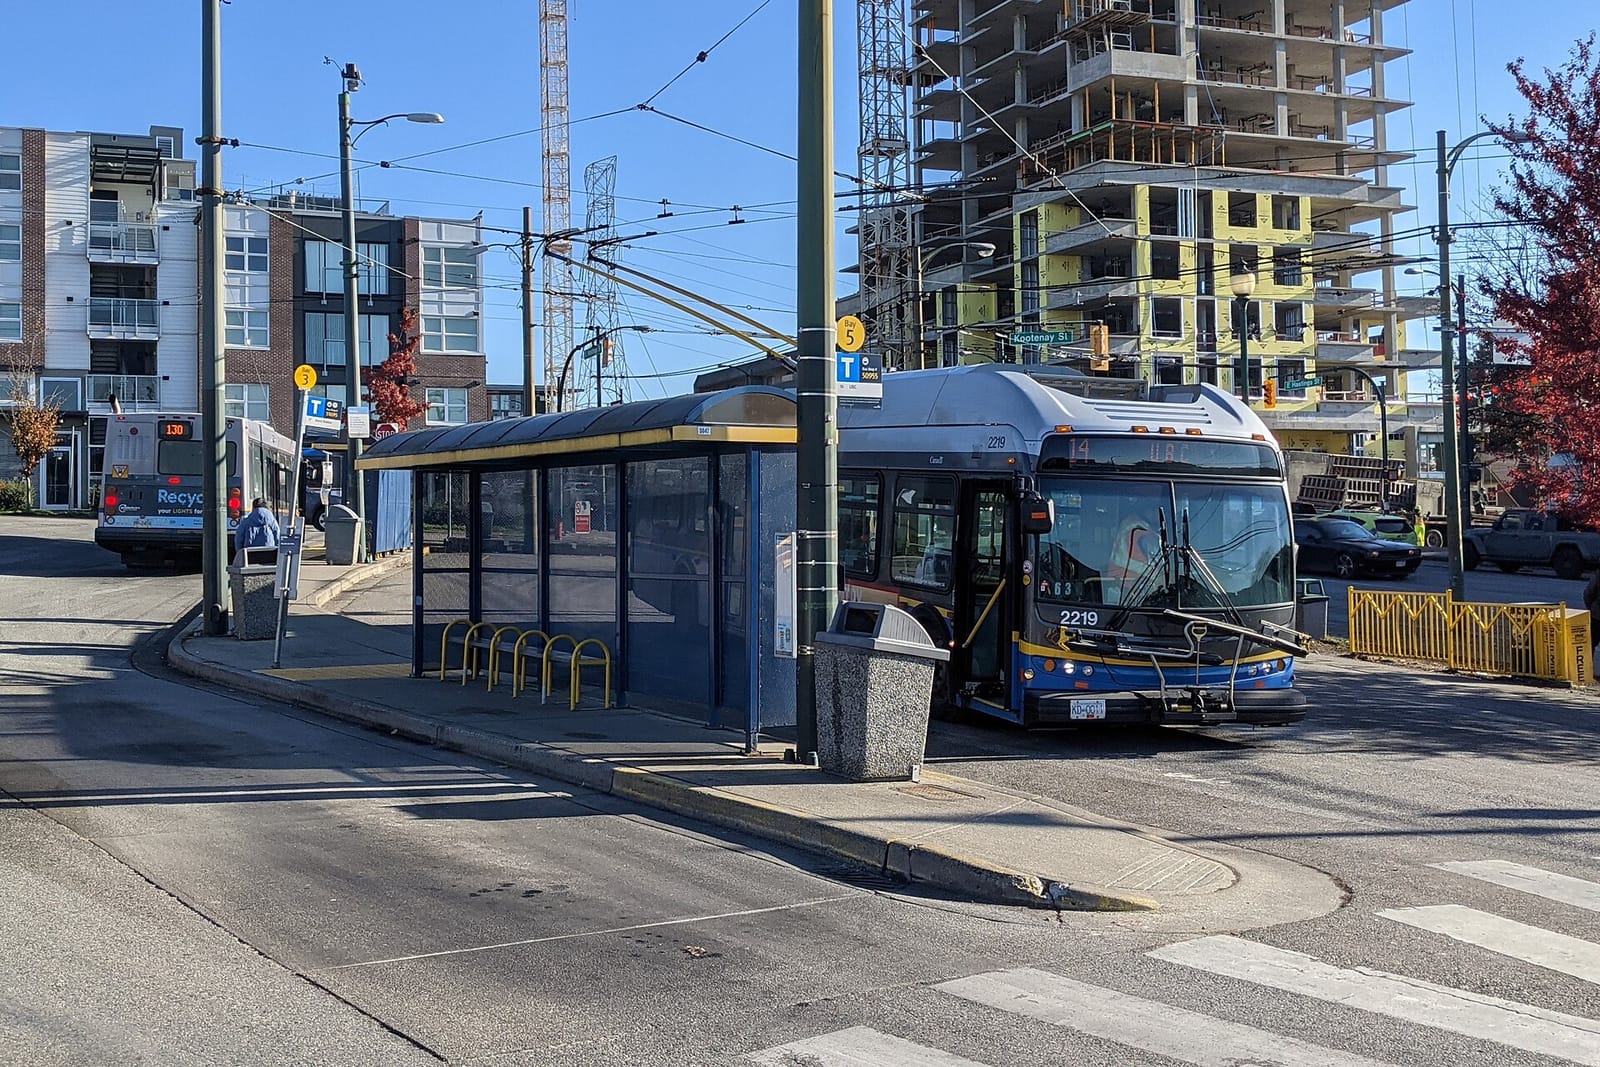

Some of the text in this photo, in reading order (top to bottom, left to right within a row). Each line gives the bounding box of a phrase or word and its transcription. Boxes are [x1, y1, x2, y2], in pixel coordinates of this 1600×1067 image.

[844, 320, 856, 328] Bay
[846, 330, 854, 345] 5
[1014, 332, 1068, 343] Kootenay St
[841, 357, 854, 378] T
[302, 374, 309, 386] 3
[310, 399, 322, 415] T
[166, 424, 184, 435] 130
[987, 436, 1006, 449] 2219
[1069, 438, 1090, 464] 14
[1060, 610, 1098, 626] 2219
[1576, 646, 1585, 682] FREE
